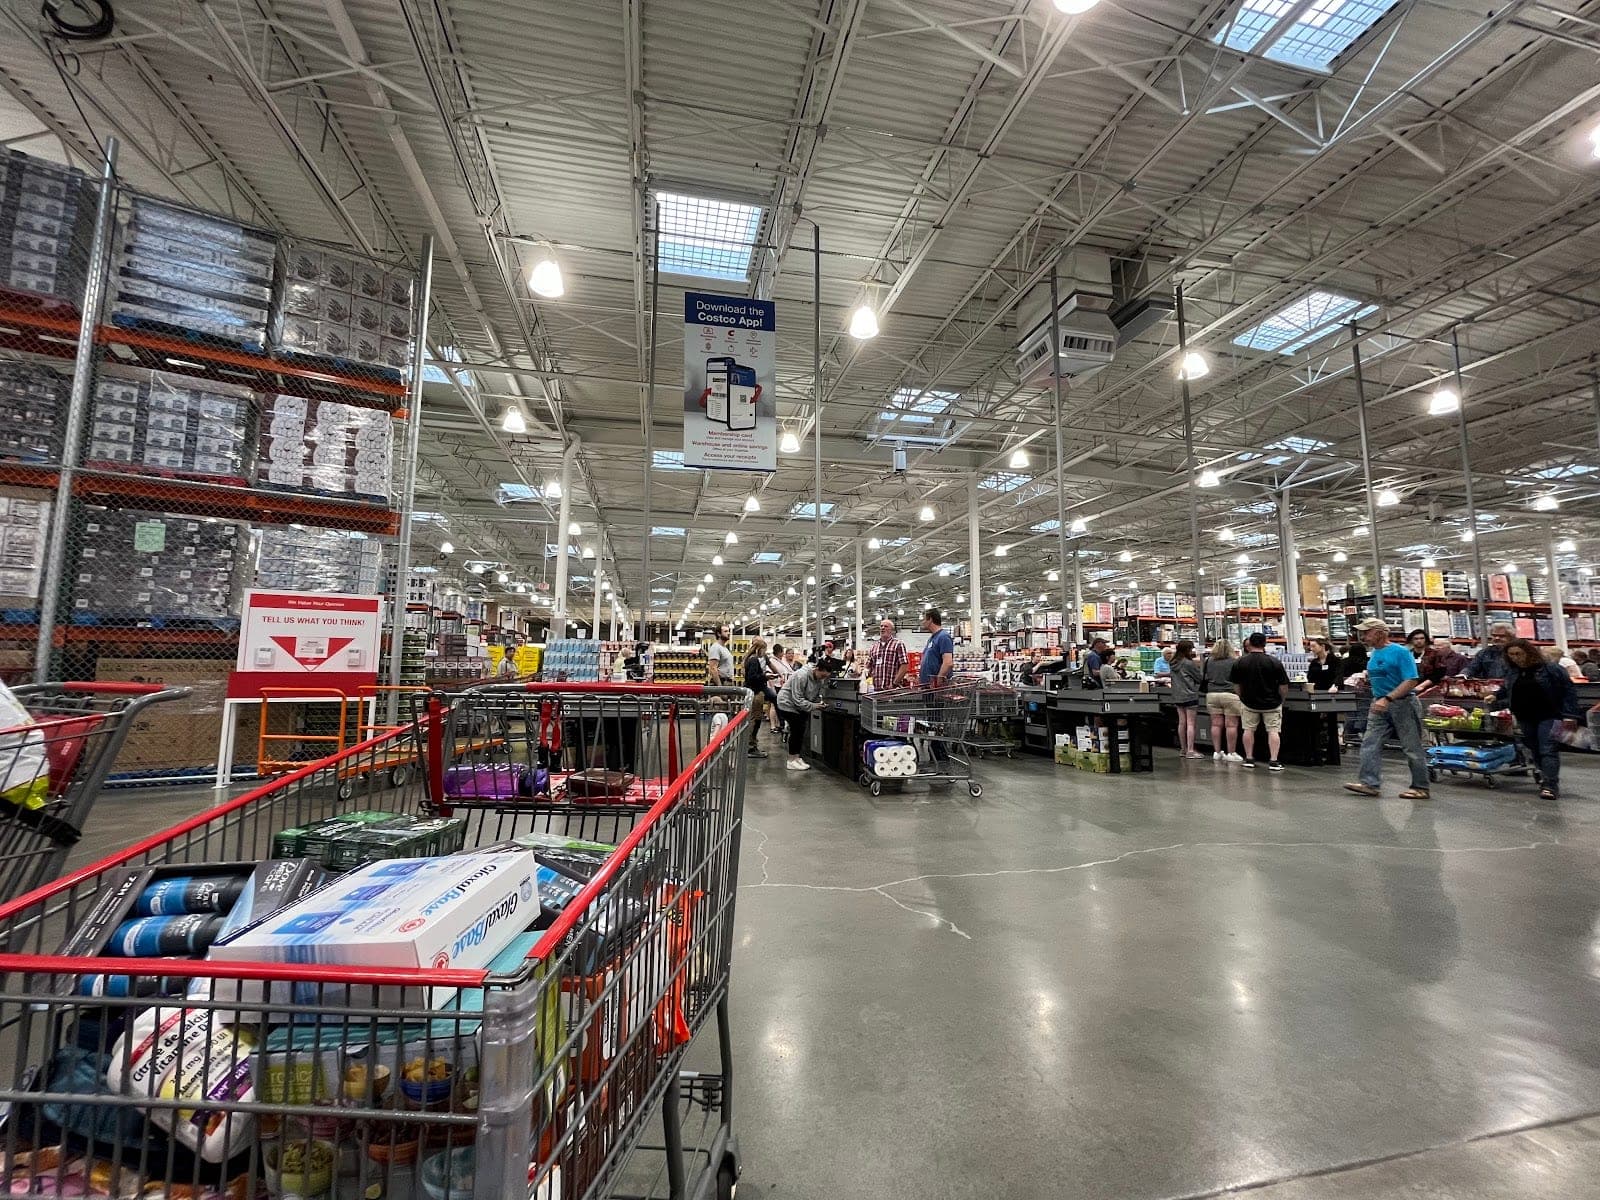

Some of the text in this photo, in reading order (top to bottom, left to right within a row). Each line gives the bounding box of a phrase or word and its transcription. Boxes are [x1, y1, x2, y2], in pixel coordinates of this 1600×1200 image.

[696, 300, 765, 317] Download the
[697, 311, 763, 328] Costco App!
[262, 616, 282, 624] TELL
[297, 617, 320, 625] WHAT
[340, 618, 366, 626] THINK!
[274, 861, 288, 882] MEN
[276, 861, 299, 892] Dove
[133, 1047, 163, 1082] Citre
[164, 1033, 179, 1047] de
[181, 1011, 211, 1033] alciu
